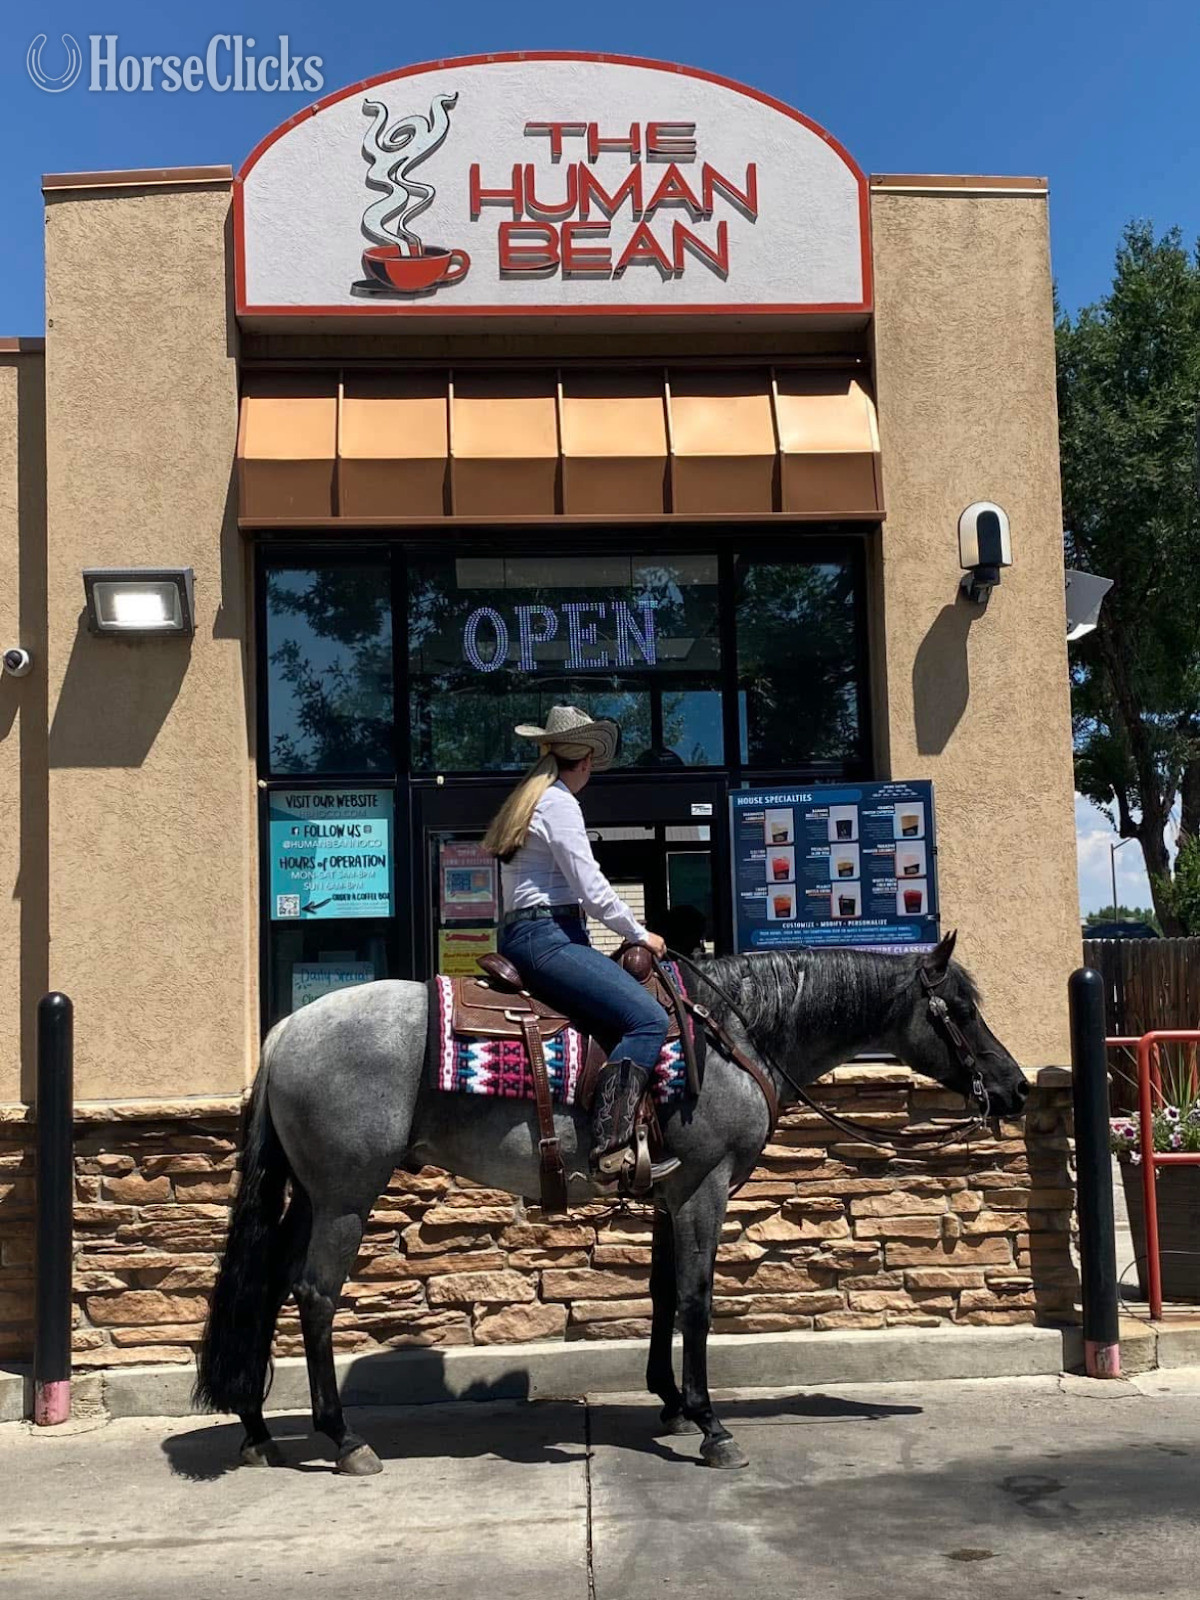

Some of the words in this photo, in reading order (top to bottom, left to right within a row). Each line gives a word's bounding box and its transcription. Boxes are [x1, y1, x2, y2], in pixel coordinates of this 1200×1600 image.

[524, 122, 697, 164] THE
[469, 161, 758, 224] HUMAN
[498, 219, 729, 282] BEAN
[464, 600, 659, 672] OPEN
[285, 795, 310, 809] VISIT
[312, 795, 335, 808] OUR
[336, 794, 378, 807] WEBSITE
[737, 796, 763, 805] HOUSE
[765, 793, 812, 803] SPECIALTIES
[304, 824, 345, 838] FOLLOW
[347, 824, 361, 838] US
[279, 856, 315, 870] HOURS
[330, 854, 386, 868] OPERATION
[782, 921, 815, 929] CUSTOMIZE
